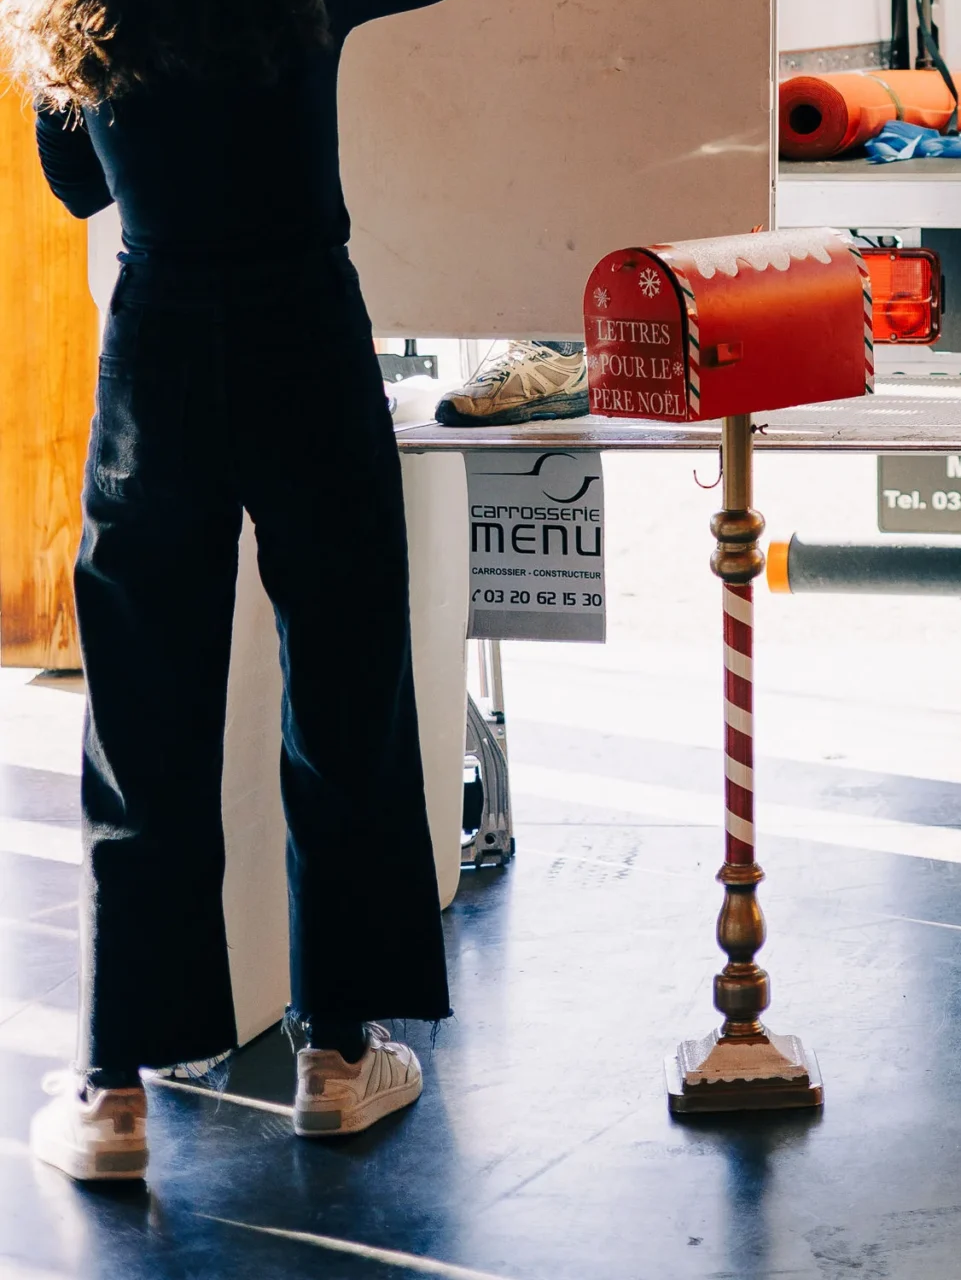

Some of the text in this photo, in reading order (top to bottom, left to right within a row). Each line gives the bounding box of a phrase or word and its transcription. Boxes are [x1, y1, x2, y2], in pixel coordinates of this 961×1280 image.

[597, 319, 671, 345] LETTRES
[600, 353, 672, 380] POUR LE
[592, 382, 686, 416] PÈRE NOËL
[883, 489, 927, 510] Tel.
[472, 567, 527, 577] CARROSSIER
[533, 569, 602, 580] CONSTRUCTEUR
[484, 589, 602, 607] 03 20 62 15 30
